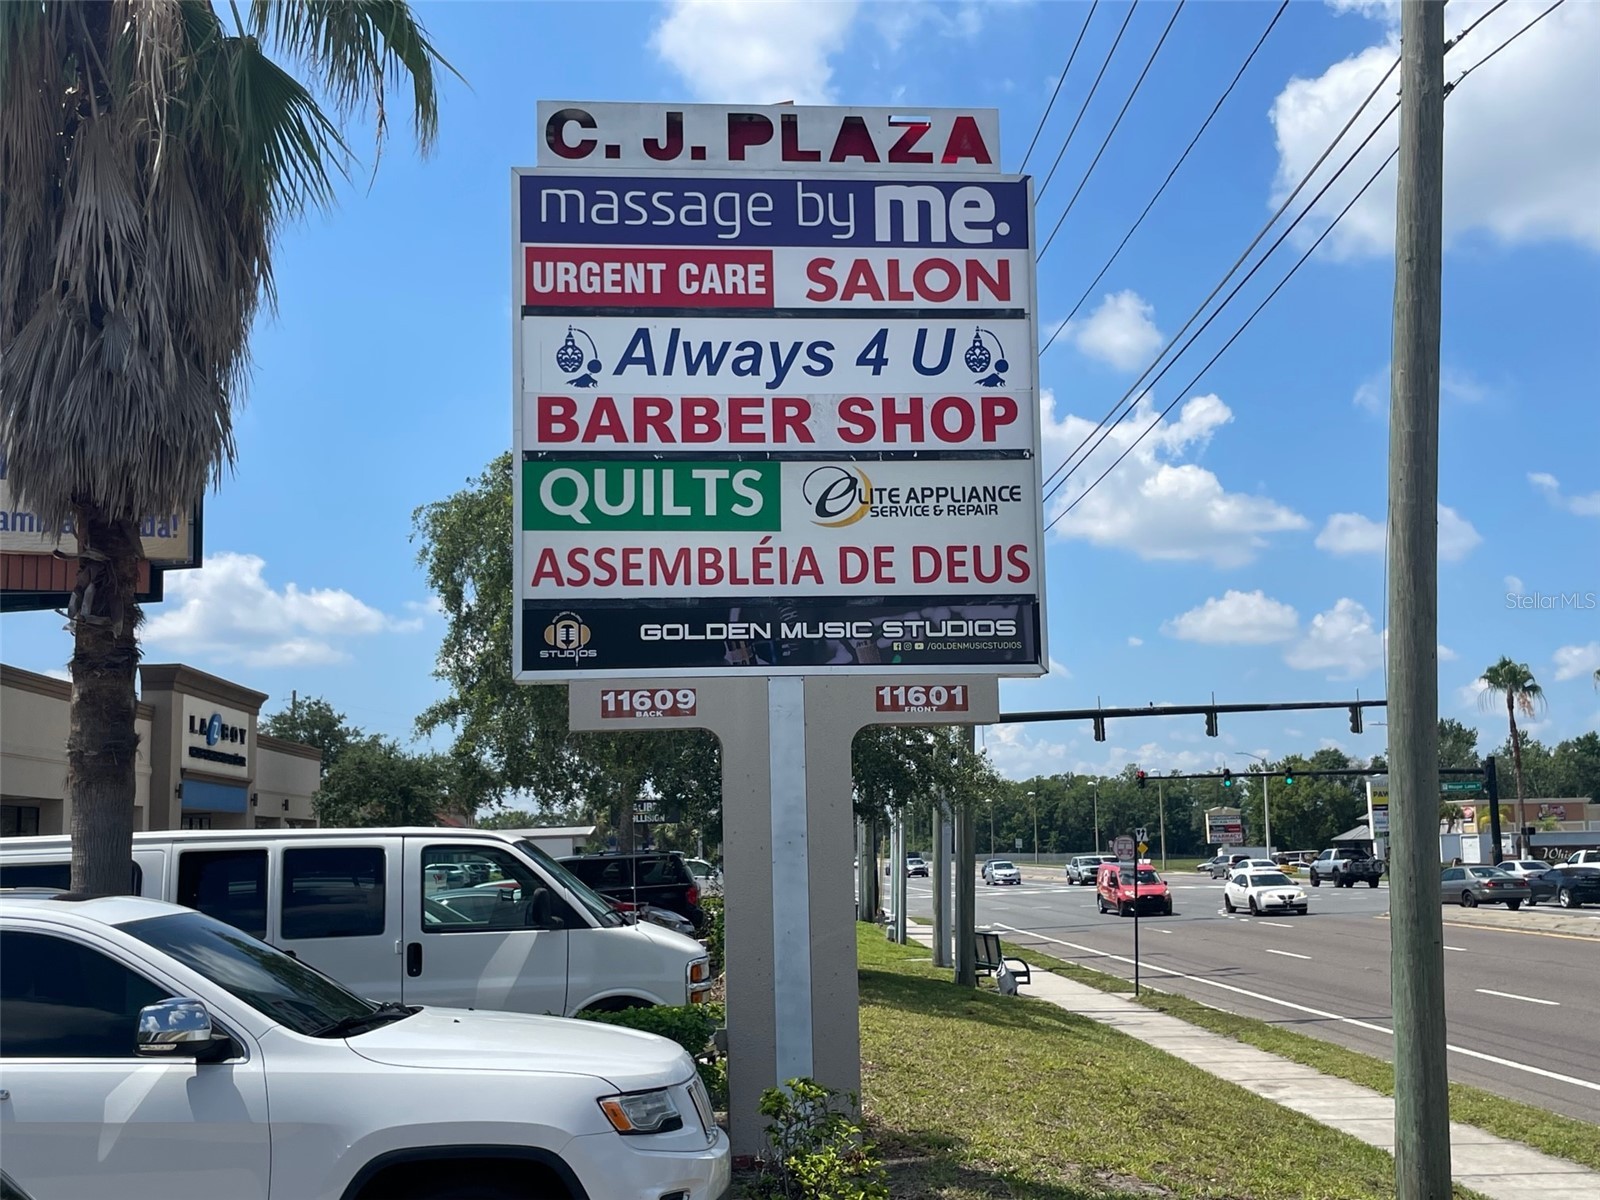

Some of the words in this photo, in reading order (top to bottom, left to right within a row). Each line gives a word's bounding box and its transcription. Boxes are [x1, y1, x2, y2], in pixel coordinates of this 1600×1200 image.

[546, 109, 620, 159] C.
[643, 112, 706, 161] J.
[728, 113, 992, 164] PLAZA
[540, 189, 773, 239] massage
[797, 182, 854, 239] by
[875, 185, 1010, 243] me.
[533, 262, 666, 293] URGENT
[679, 263, 766, 294] CARE
[806, 258, 1010, 302] SALON
[613, 328, 835, 389] Always
[856, 328, 888, 375] 4
[912, 328, 956, 376] U
[537, 397, 815, 443] BARBER
[837, 397, 1018, 443] SHOP
[540, 468, 763, 524] QUILTS
[870, 504, 929, 518] SERVICE
[933, 503, 944, 516] &
[947, 503, 998, 516] REPAIR
[905, 486, 1021, 504] APPLIANCE
[532, 536, 824, 587] ASSEMBLÉIA
[840, 546, 895, 584] DE
[913, 545, 1030, 583] DEUS
[641, 623, 770, 640] GOLDEN
[781, 622, 872, 638] MUSIC
[883, 620, 1016, 637] STUDIOS
[927, 641, 1022, 650] /GOLDENMUSICSTUDIOS
[602, 689, 695, 711] 11609
[879, 685, 963, 706] 11601
